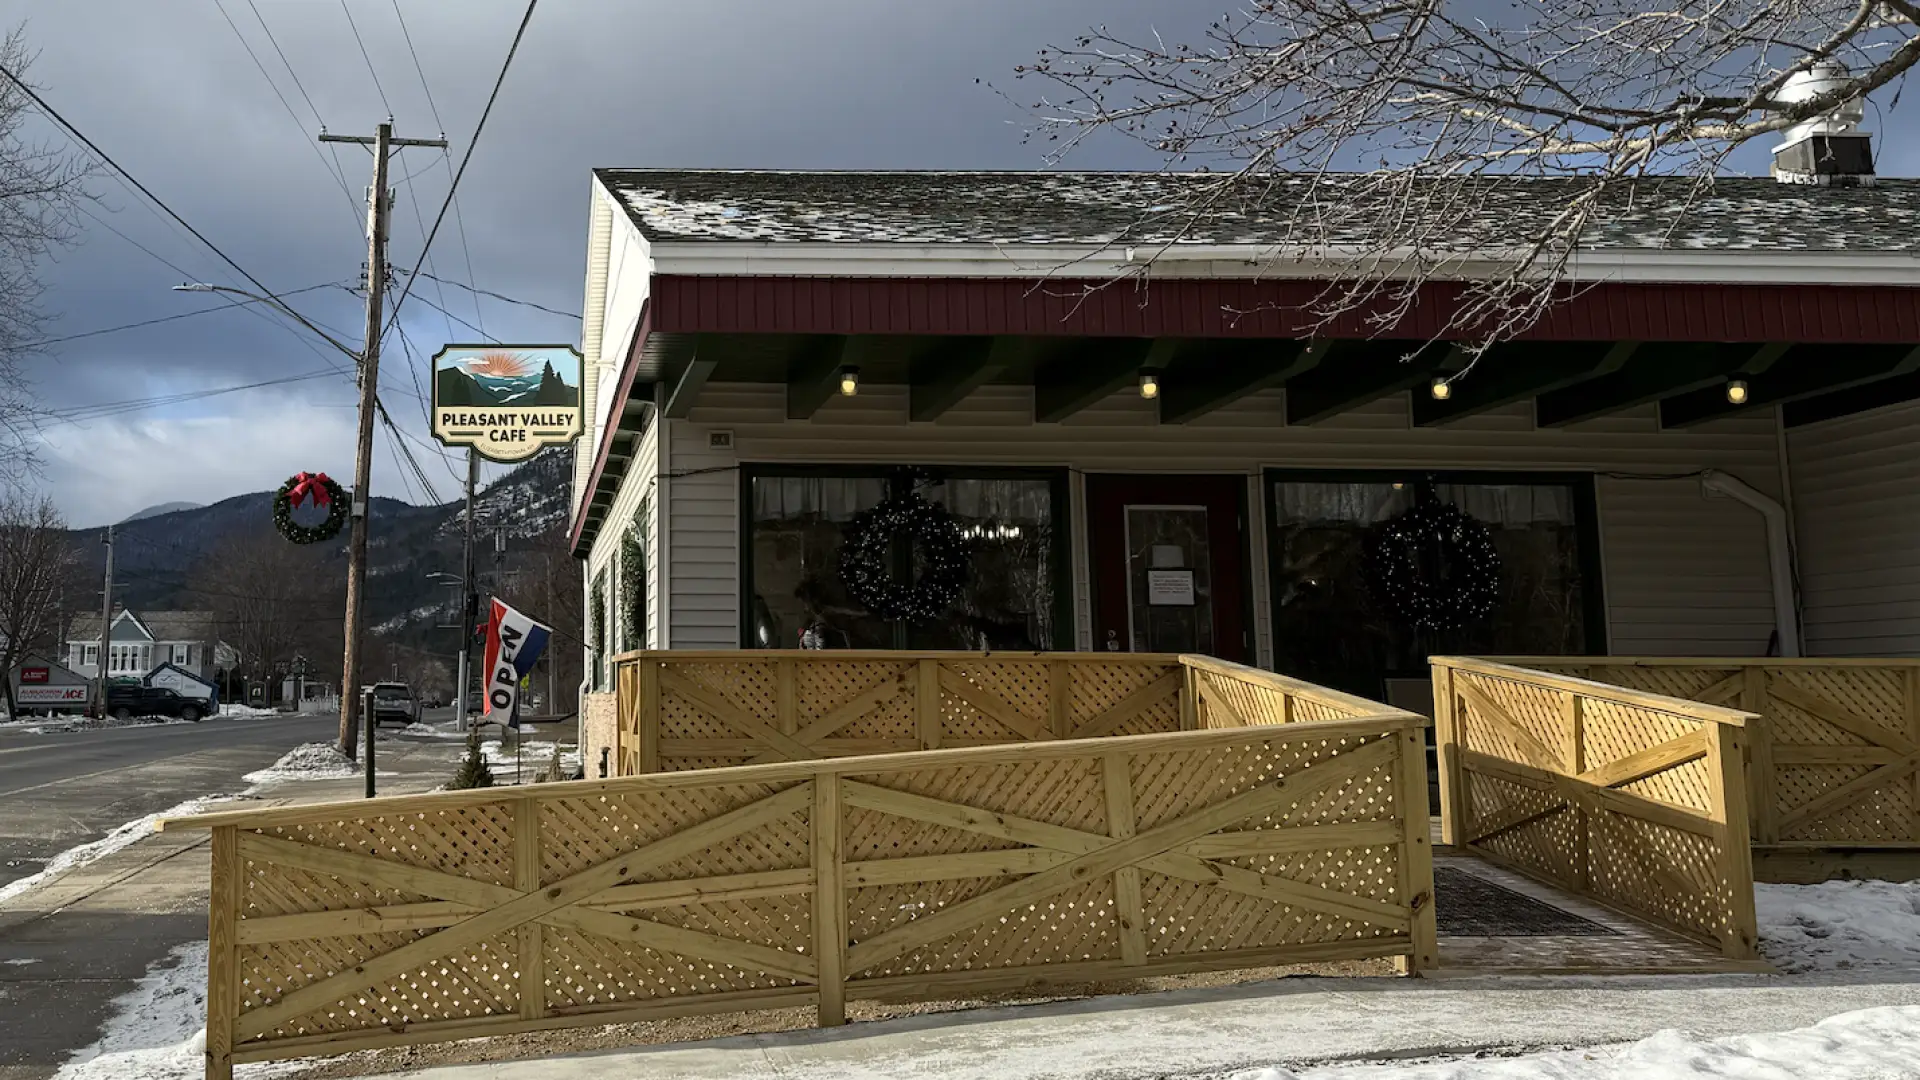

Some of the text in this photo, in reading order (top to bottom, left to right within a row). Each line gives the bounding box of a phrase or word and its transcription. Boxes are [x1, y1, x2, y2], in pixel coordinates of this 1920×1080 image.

[442, 413, 574, 427] PLEASANT VALLEY
[490, 624, 523, 709] OPEN
[62, 688, 85, 699] ACE
